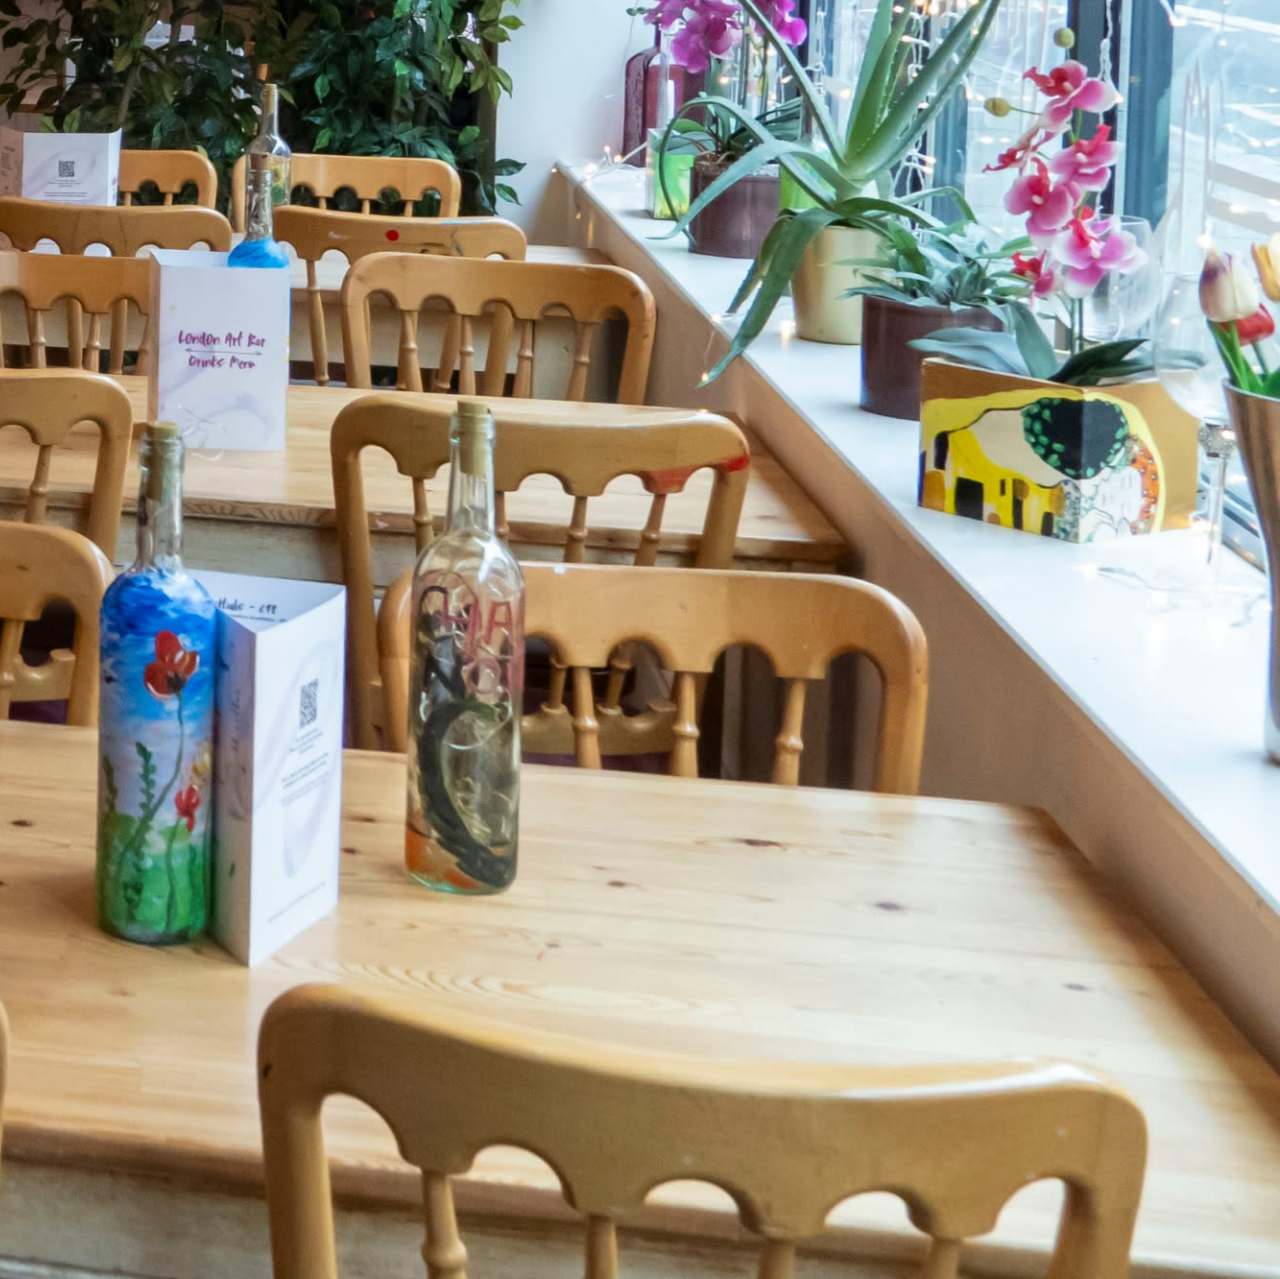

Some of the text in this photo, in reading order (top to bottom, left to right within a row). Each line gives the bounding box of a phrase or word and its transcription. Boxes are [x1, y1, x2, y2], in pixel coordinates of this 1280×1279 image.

[178, 329, 266, 348] London Art Bar
[188, 355, 224, 367] Drinks
